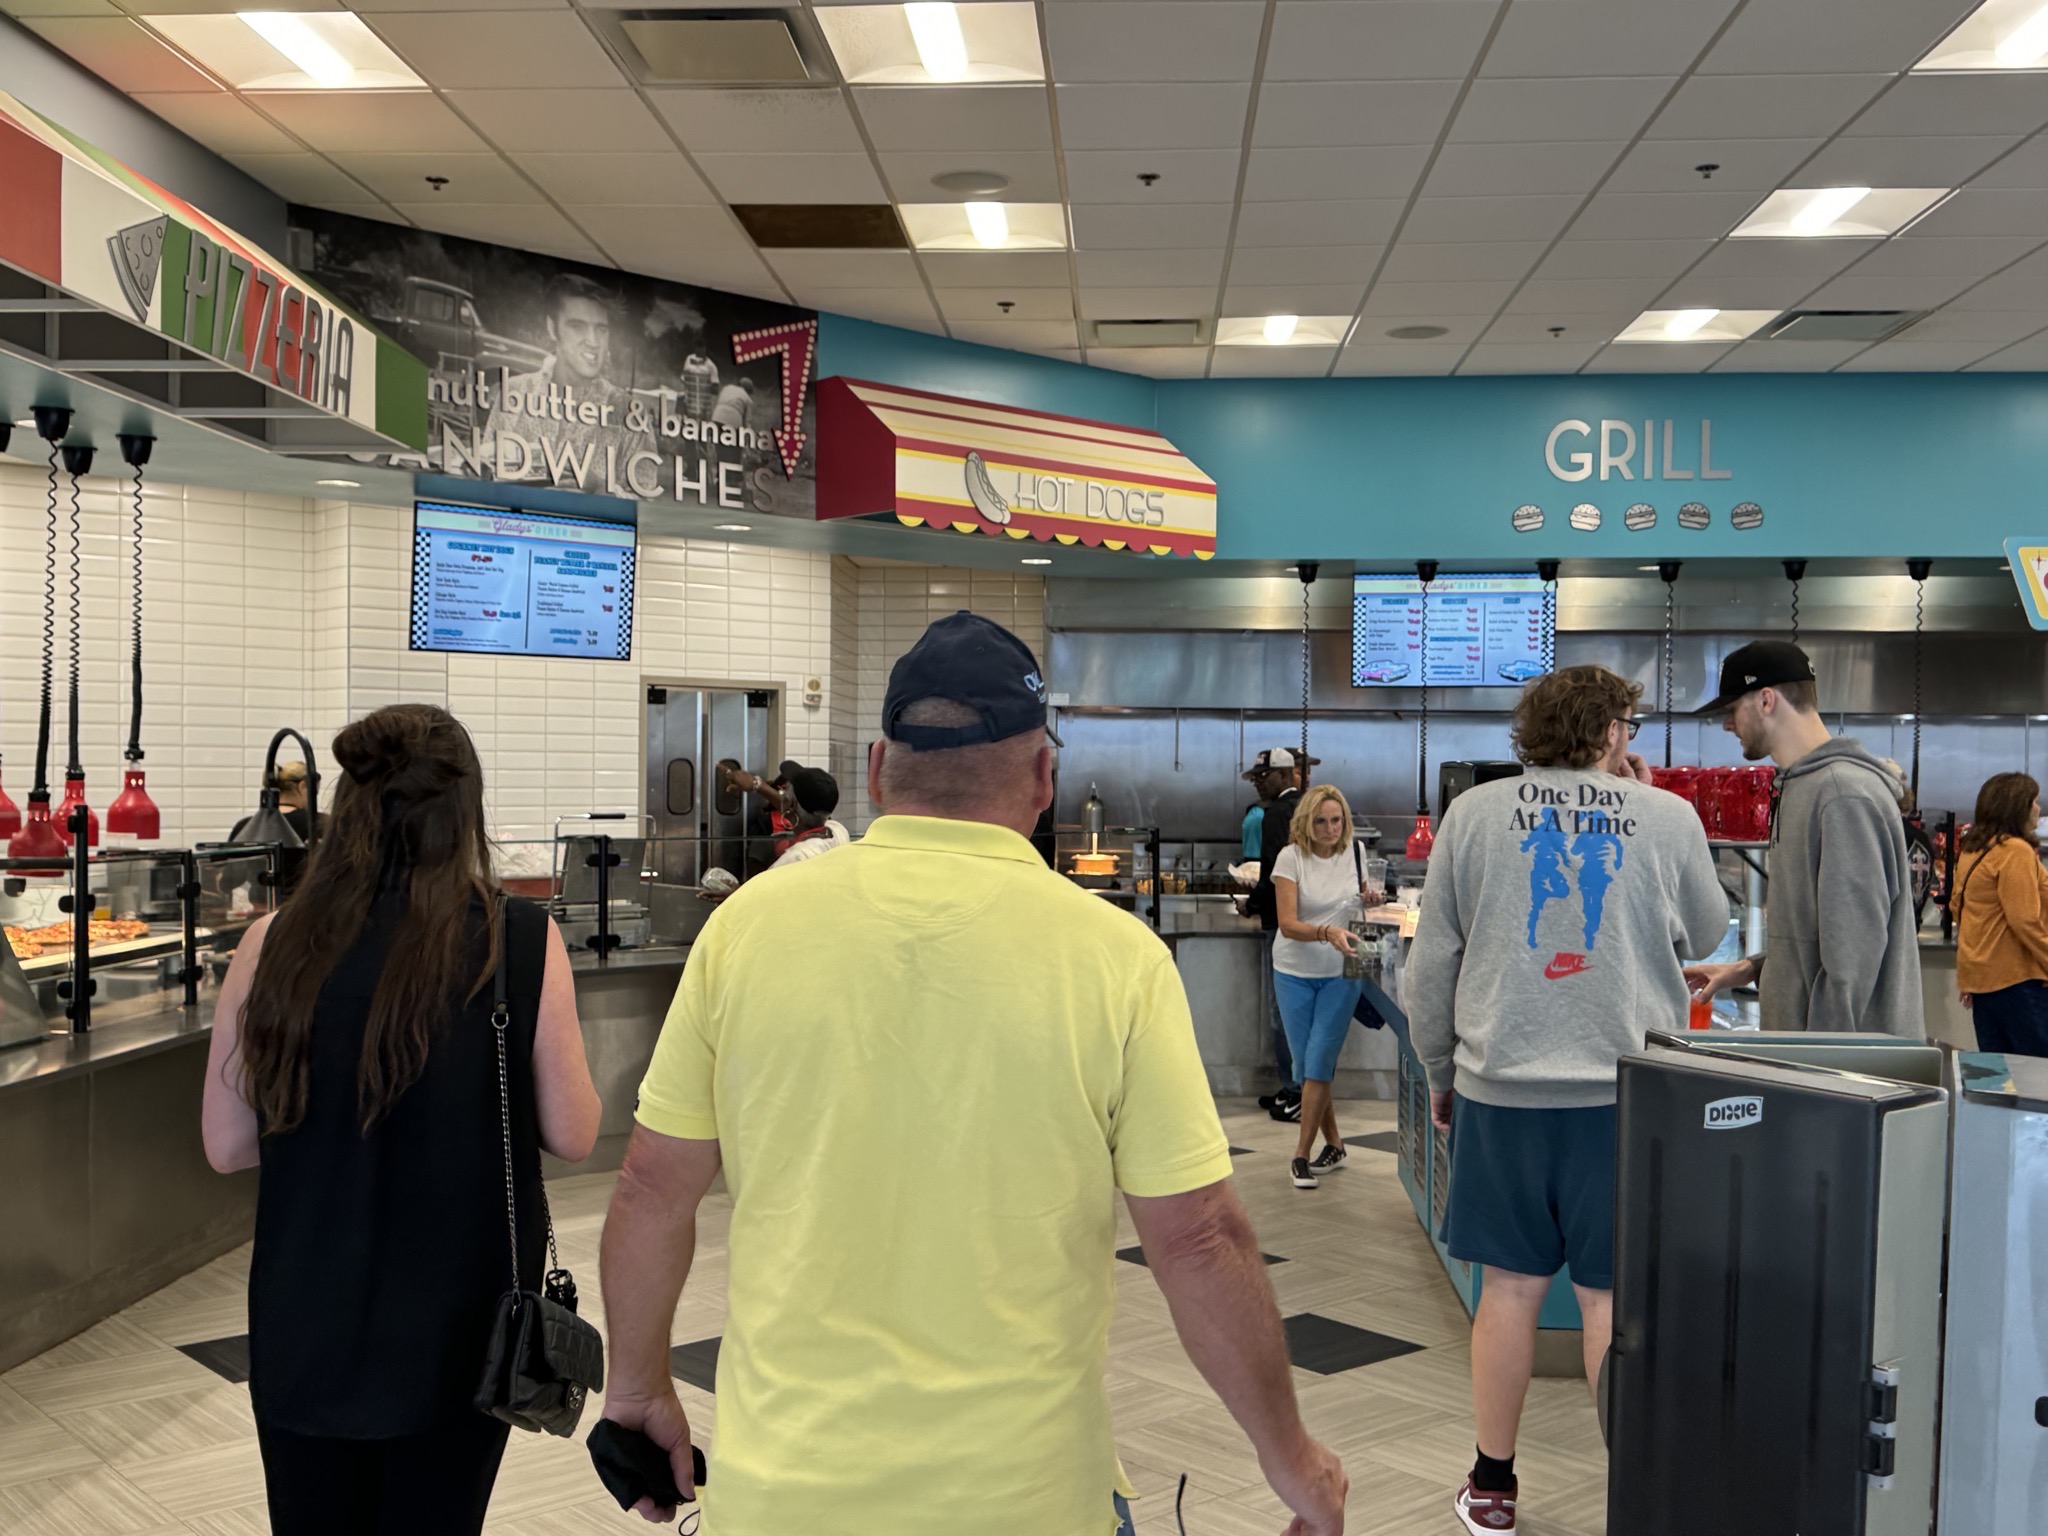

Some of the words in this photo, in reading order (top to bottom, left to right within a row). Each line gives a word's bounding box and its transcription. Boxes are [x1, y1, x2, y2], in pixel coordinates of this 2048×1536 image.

[183, 228, 354, 418] PIZZERIA
[499, 366, 614, 427] butter
[625, 398, 652, 433] &
[660, 394, 775, 451] banana
[346, 423, 778, 513] NDWICHES
[1544, 418, 1732, 483] GRILL
[1015, 472, 1075, 514] HOT
[1086, 481, 1165, 526] DOGS
[1509, 807, 1538, 831] At
[1544, 809, 1563, 833] A
[1567, 809, 1636, 837] Time
[1518, 782, 1570, 805] One
[1578, 783, 1630, 814] Day
